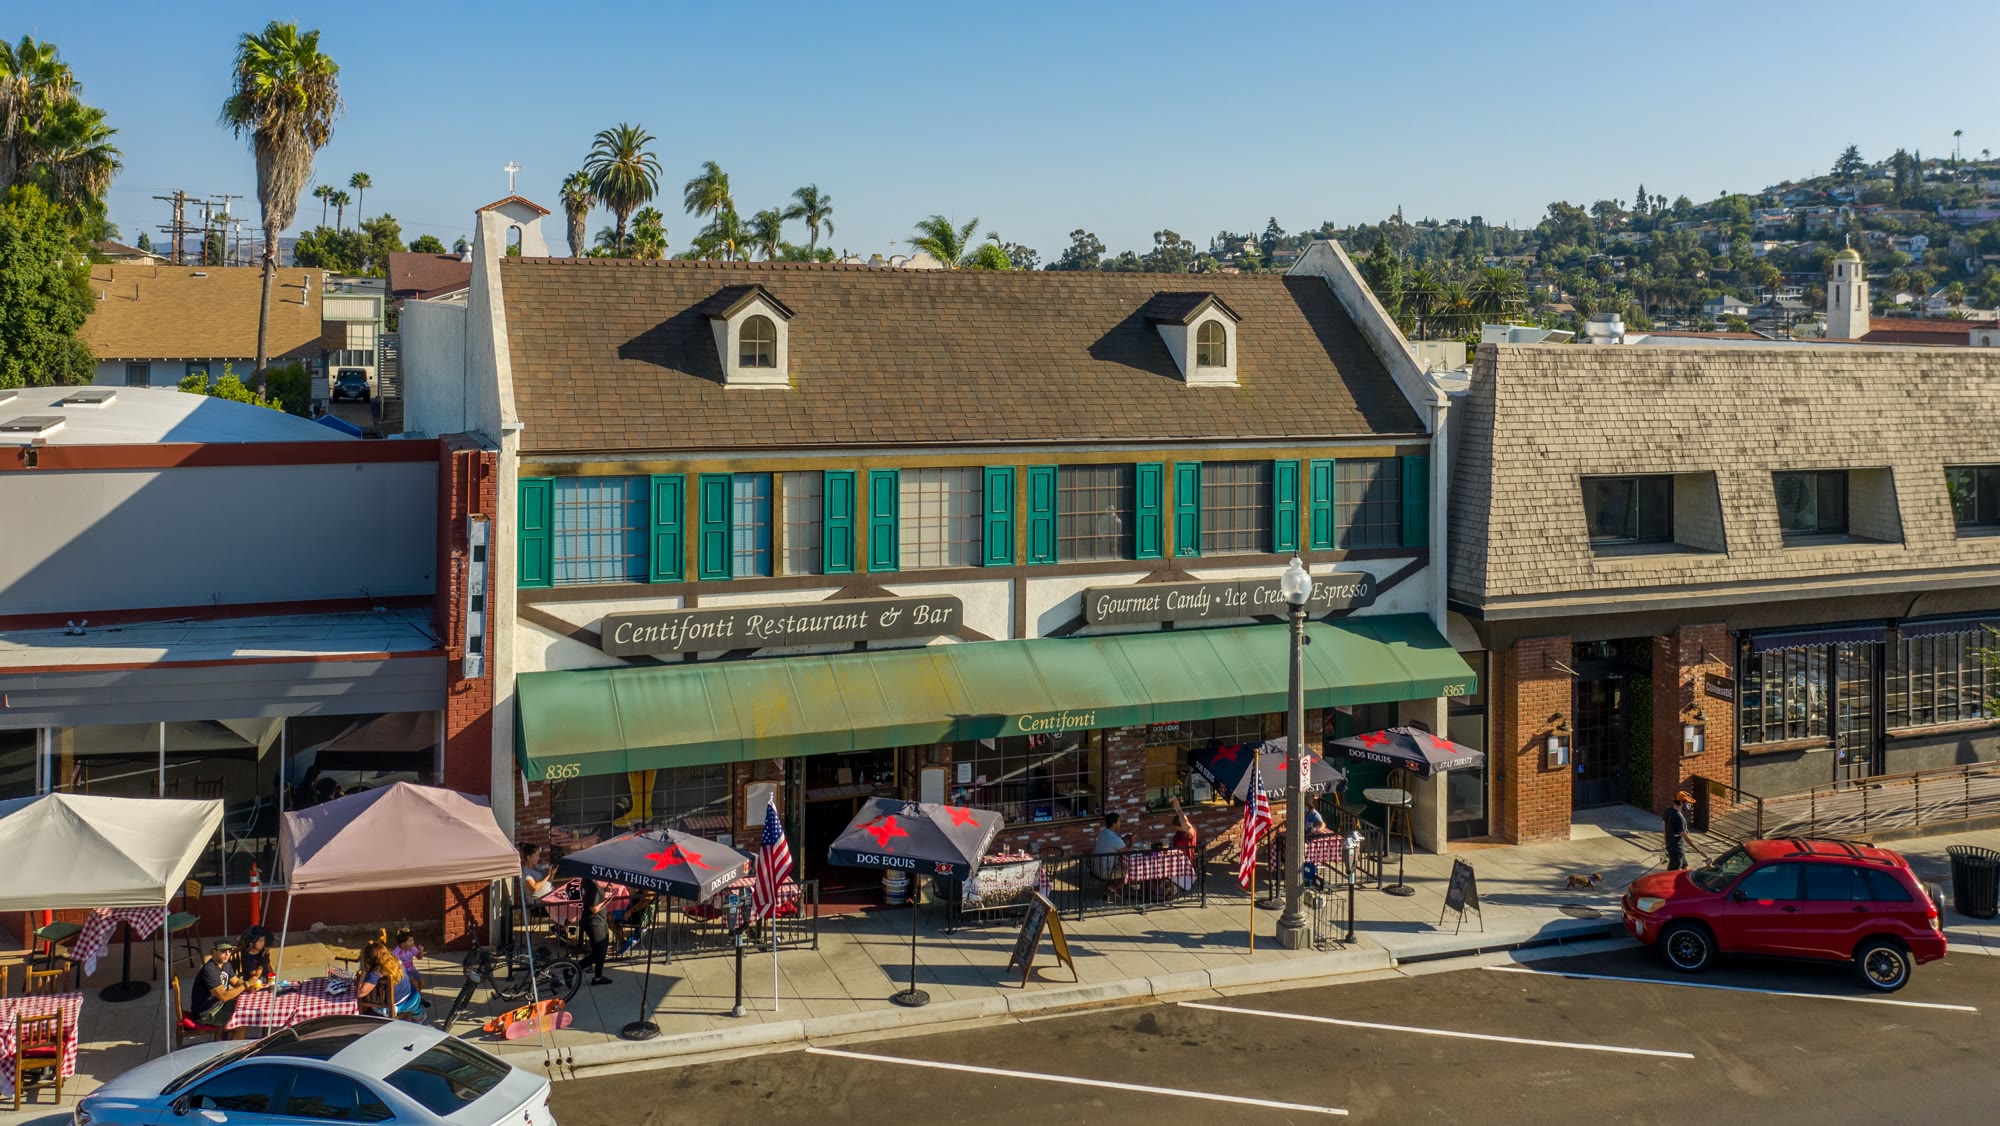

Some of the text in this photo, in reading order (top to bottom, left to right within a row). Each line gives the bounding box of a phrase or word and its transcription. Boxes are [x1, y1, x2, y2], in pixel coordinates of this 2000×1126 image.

[1096, 594, 1161, 621] Gourmet
[1166, 586, 1211, 616] Candy
[1224, 588, 1247, 607] Ice
[1253, 585, 1288, 605] Crea
[1311, 582, 1368, 607] Espresso
[614, 604, 953, 650] Centifonti Restaurant & Bar
[1442, 684, 1465, 697] 8365
[1705, 681, 1733, 698] CURBSIDE
[1017, 710, 1096, 732] Centifonti
[1348, 748, 1392, 764] DOS EQUIS
[545, 763, 581, 780] 8365
[1264, 787, 1286, 799] TAY
[856, 853, 916, 869] DOS EQUIS
[591, 865, 673, 892] STAY THIRSTY
[710, 868, 738, 892] DOS EQUIS
